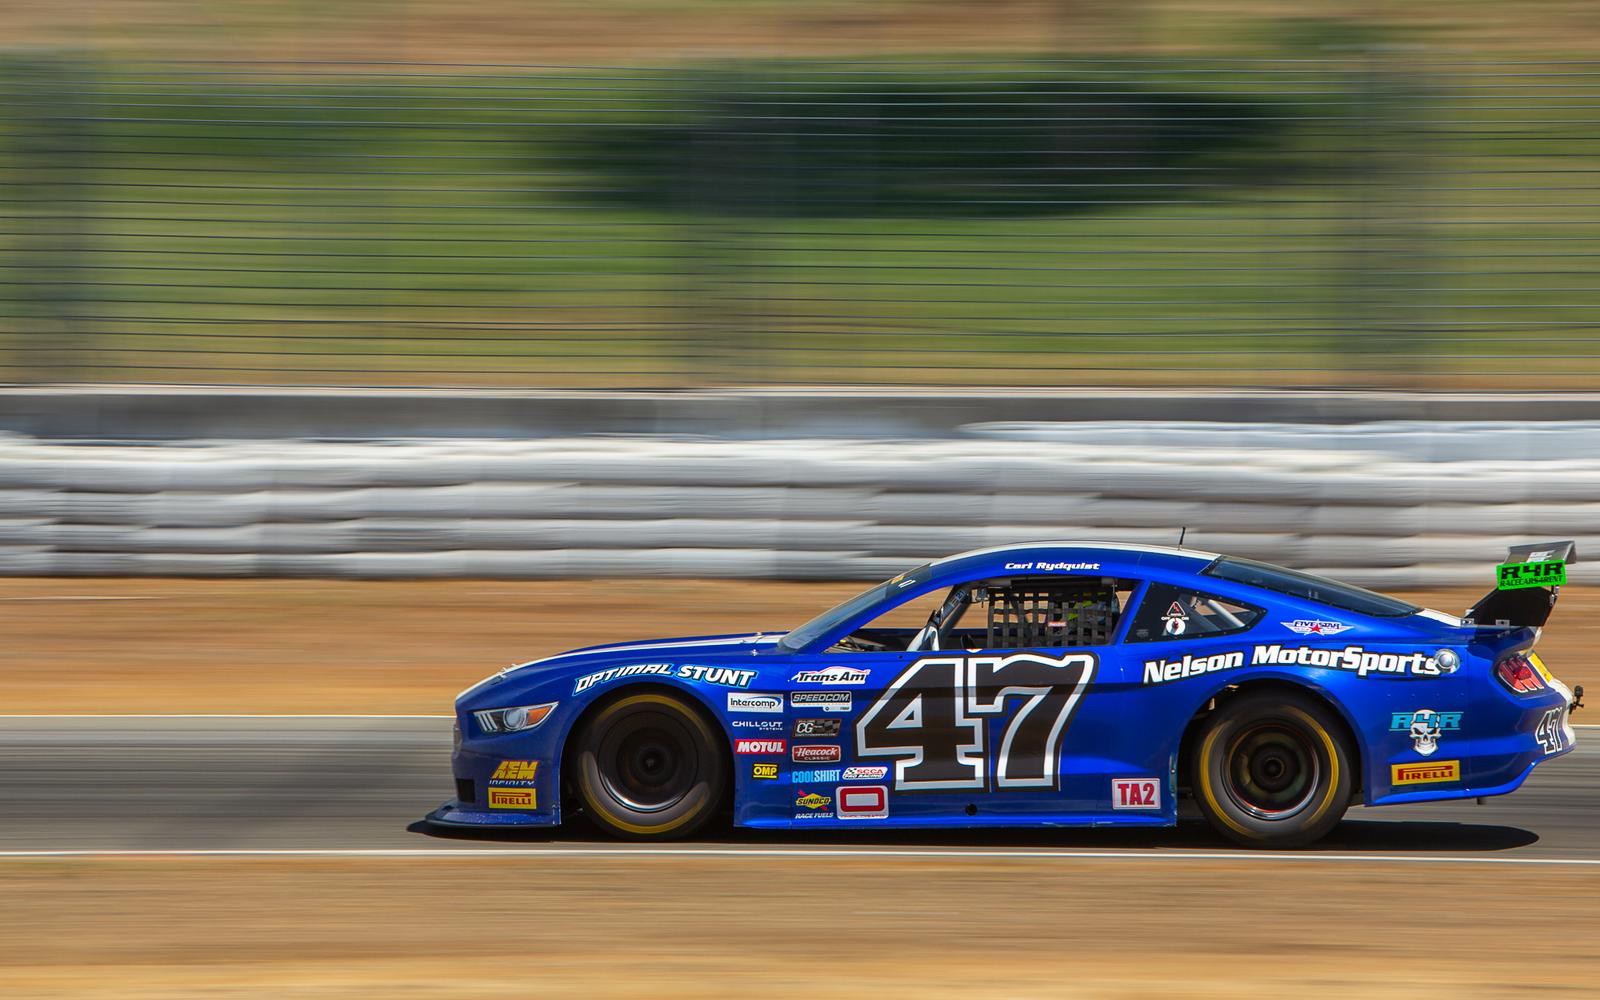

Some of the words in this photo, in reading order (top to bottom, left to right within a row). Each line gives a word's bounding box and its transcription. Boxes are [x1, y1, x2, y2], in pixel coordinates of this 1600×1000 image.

[1005, 562, 1033, 570] Carl
[1036, 562, 1100, 571] Rydquist
[1501, 562, 1564, 579] R4R
[1143, 652, 1243, 684] Nelson
[1252, 645, 1442, 676] MotorSports
[575, 664, 673, 694] OPTIMAL
[678, 665, 757, 688] STUNT
[800, 672, 836, 681] Trans
[839, 672, 866, 681] Am
[730, 698, 776, 709] Intercomp
[793, 693, 849, 702] SPEEDCOM
[855, 653, 1095, 792] 47
[1391, 713, 1462, 729] R4R
[1535, 706, 1563, 754] 47
[737, 741, 784, 753] MOTUL
[795, 747, 838, 757] Heacock
[492, 761, 539, 780] AEM
[754, 767, 777, 776] OMP
[792, 769, 841, 784] COOLSHIRT
[1398, 765, 1454, 780] PIRELLI
[492, 792, 532, 805] PIRELLI
[797, 797, 830, 805] SUNOCO
[1117, 783, 1155, 806] TA2
